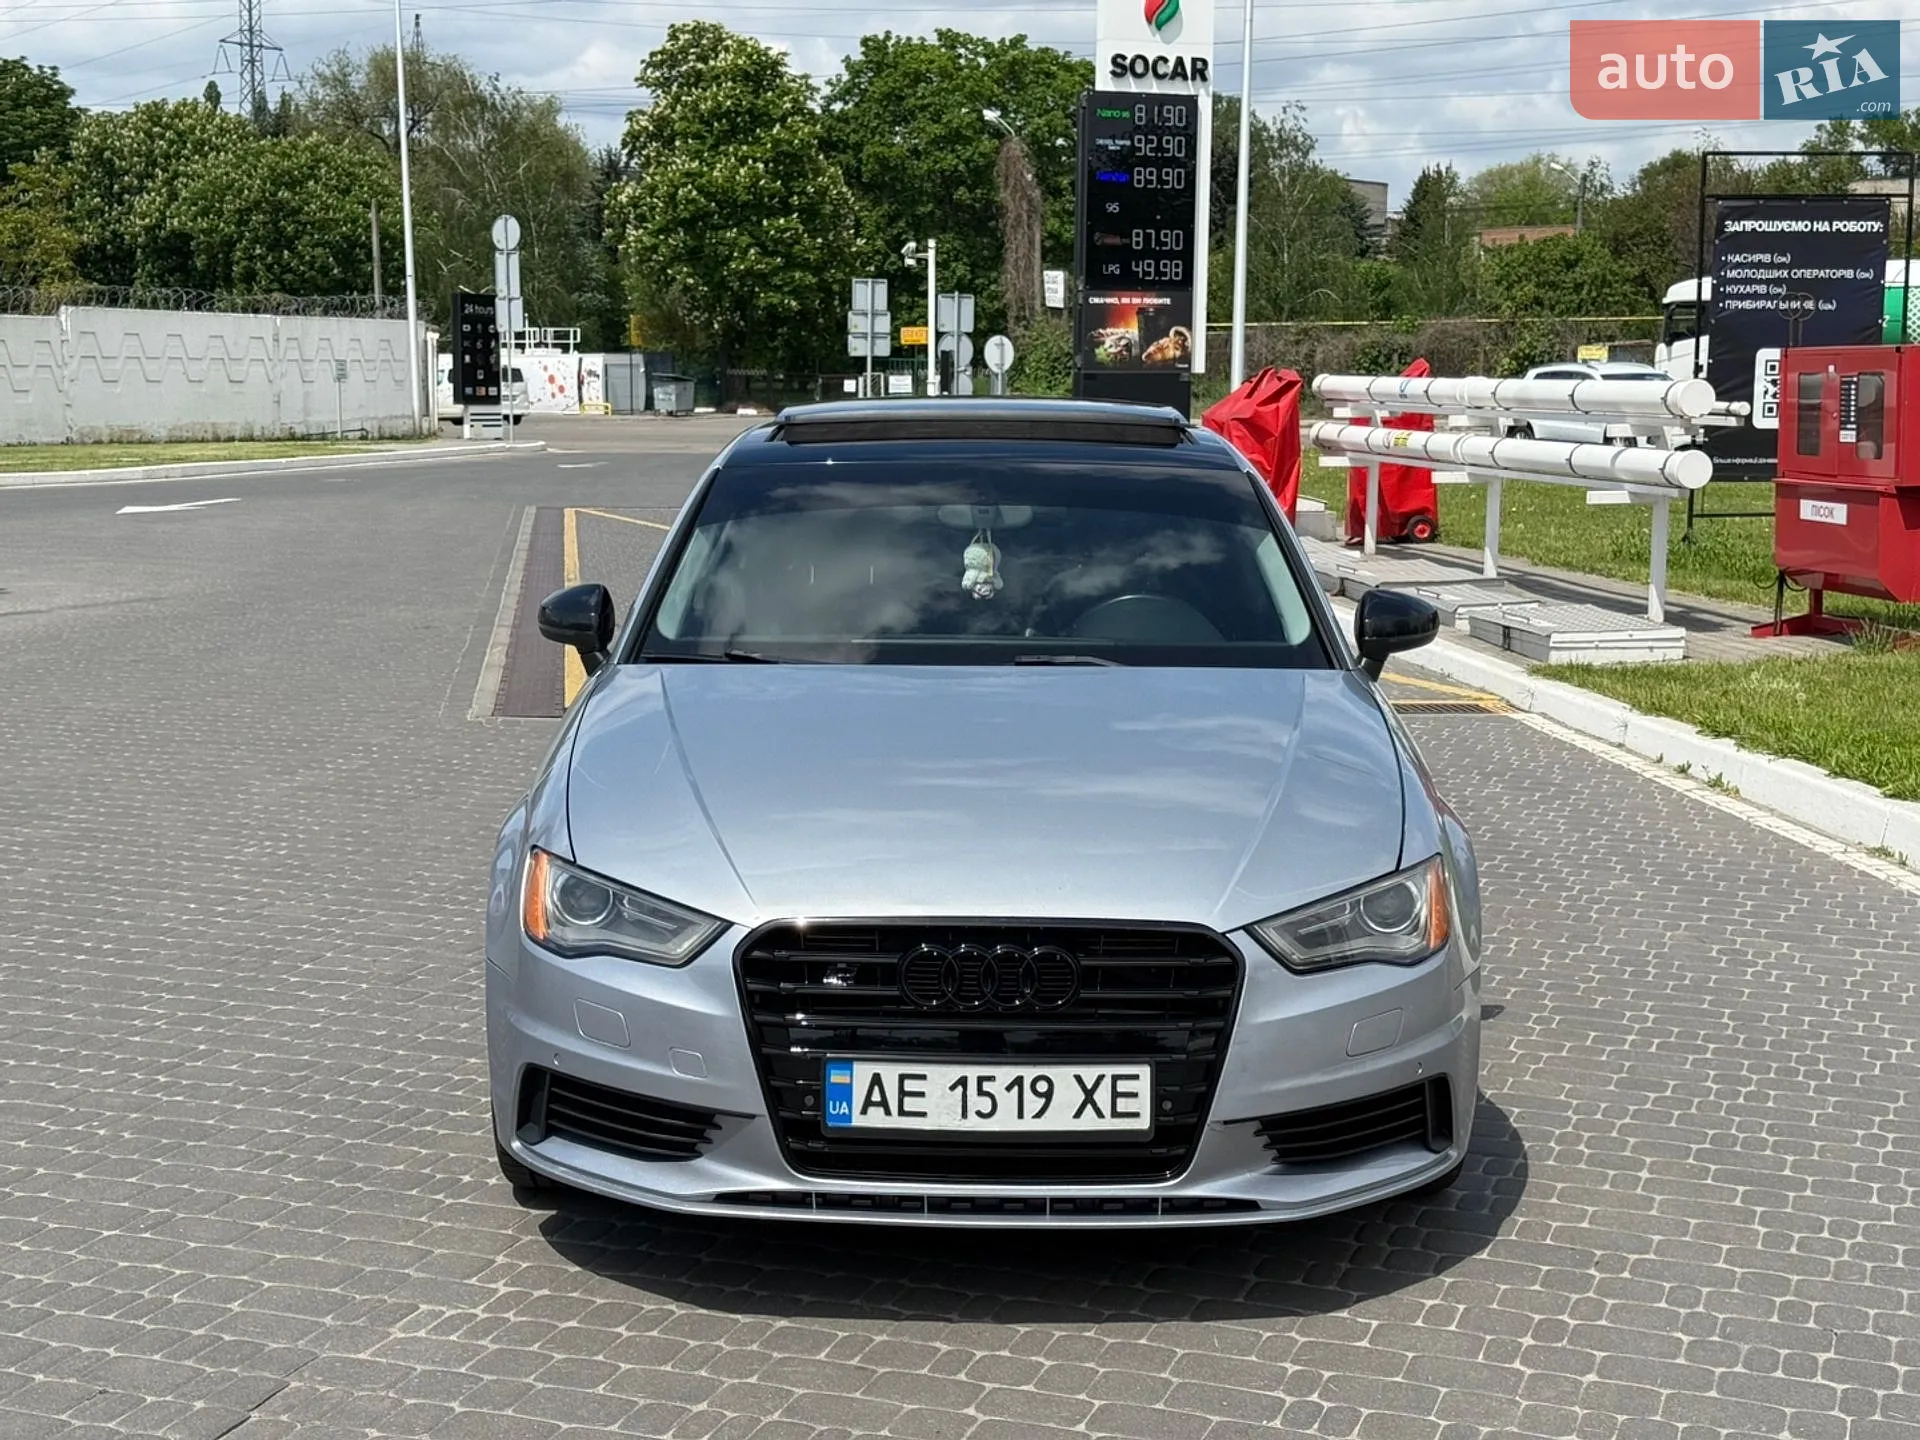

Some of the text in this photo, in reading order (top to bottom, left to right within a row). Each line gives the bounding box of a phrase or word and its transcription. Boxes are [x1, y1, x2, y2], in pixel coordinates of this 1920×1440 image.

[1109, 53, 1209, 82] SOCAR
[1135, 104, 1186, 126] 81.90
[1134, 135, 1186, 157] 92.90
[1133, 167, 1185, 189] 89.90
[1105, 203, 1120, 213] 95
[1724, 221, 1884, 232] ЗАПРОШУЄМО НА РОБОТУ:
[1132, 229, 1183, 250] 87.90
[1727, 254, 1772, 263] КАСИРІВ
[1103, 260, 1182, 280] LPG 49.98
[1726, 269, 1789, 279] МОЛОДШИХ
[1790, 269, 1855, 279] ОПЕРАТОРІВ
[1725, 285, 1767, 294] КУХАРІВ
[464, 303, 474, 314] 24
[829, 1072, 1141, 1120] UA AE 1519 XE
